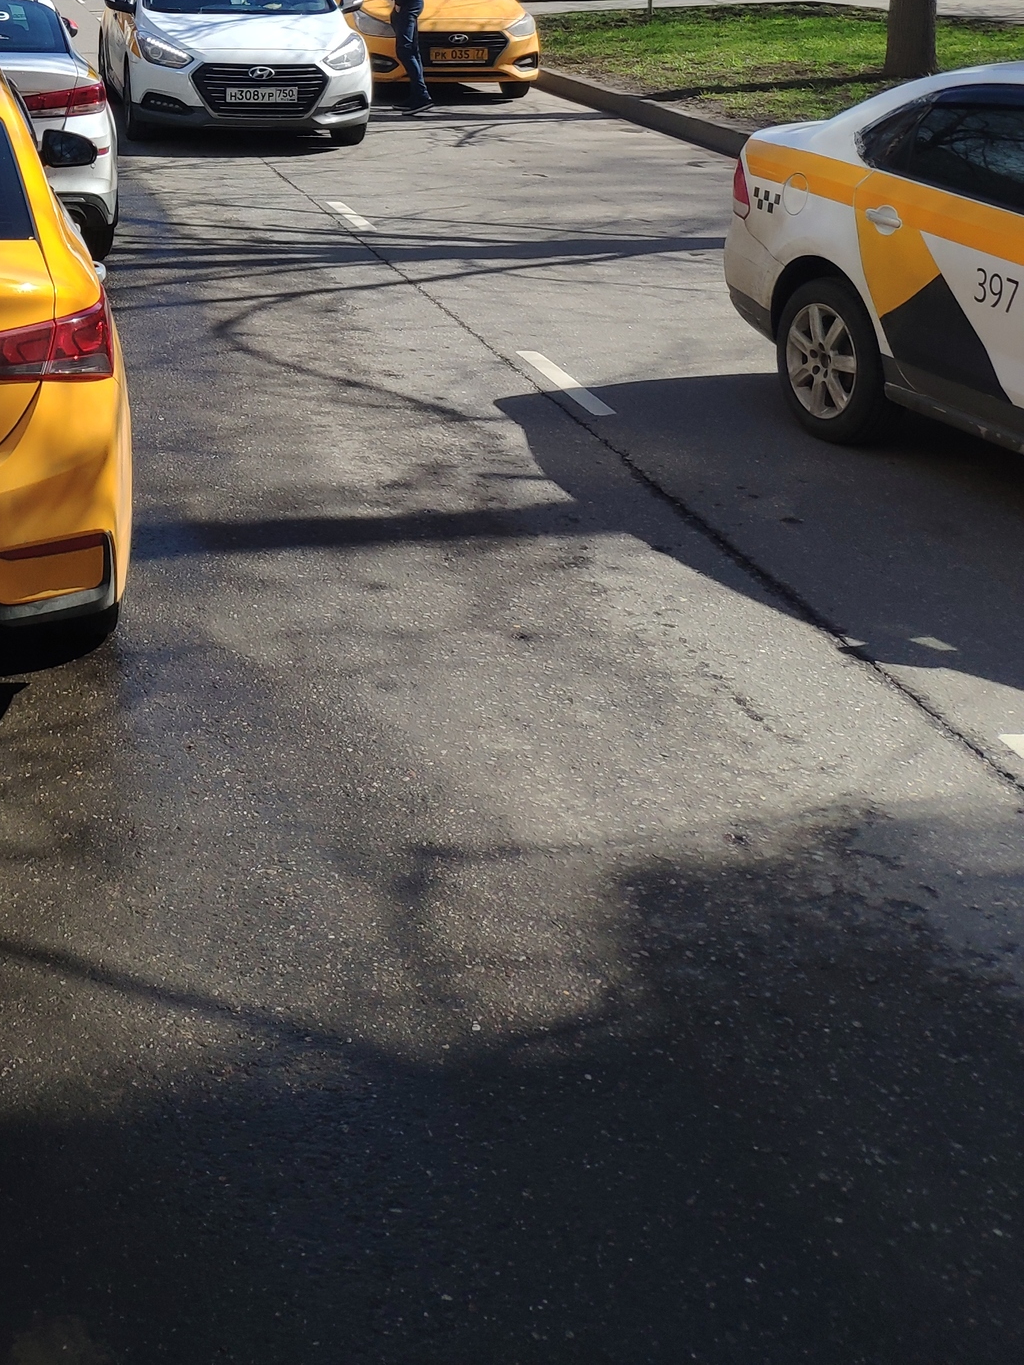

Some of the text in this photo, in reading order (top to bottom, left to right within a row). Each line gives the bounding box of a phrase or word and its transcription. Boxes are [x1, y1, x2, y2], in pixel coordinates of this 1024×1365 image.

[451, 49, 470, 60] 035
[229, 89, 275, 102] Н308УР
[973, 267, 1020, 314] 397
